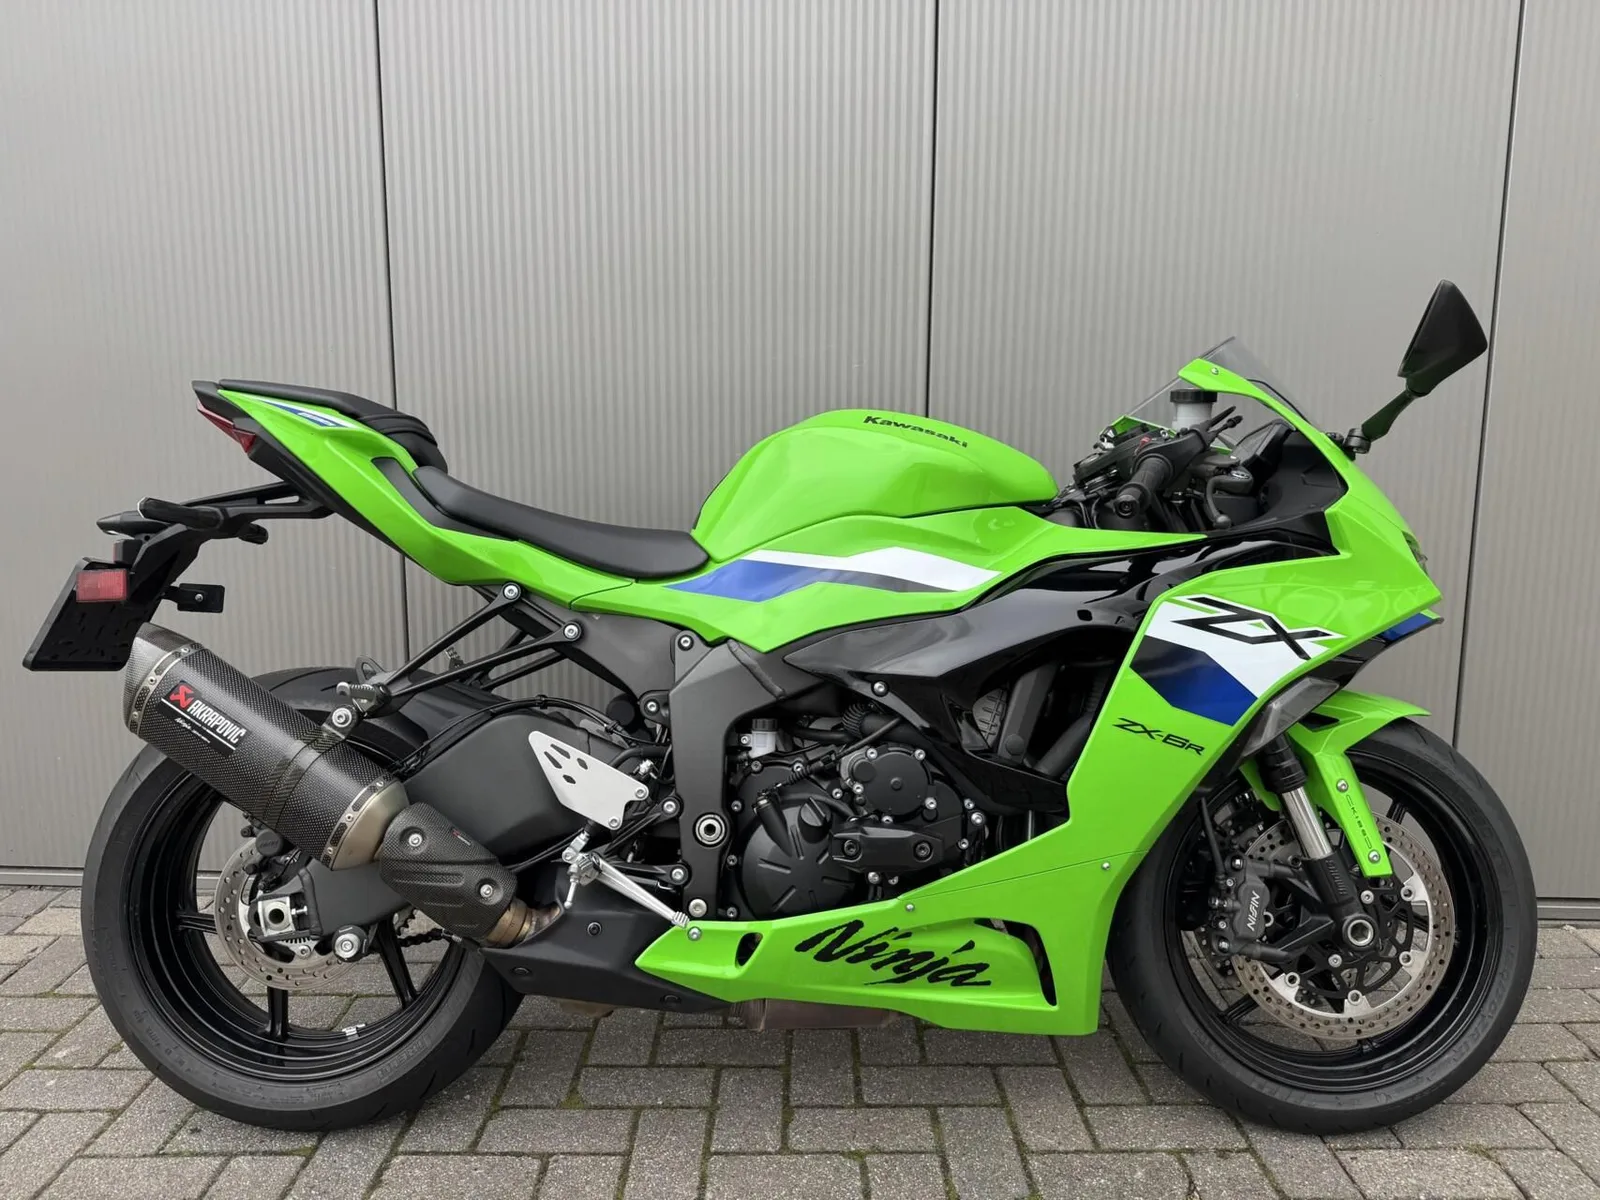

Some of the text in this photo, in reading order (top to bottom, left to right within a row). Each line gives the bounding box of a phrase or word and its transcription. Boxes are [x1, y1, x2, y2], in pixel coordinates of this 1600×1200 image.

[863, 416, 968, 448] Kawasaki
[1170, 596, 1334, 660] ZX
[1112, 717, 1205, 756] ZX-6R
[795, 919, 992, 987] Ninja
